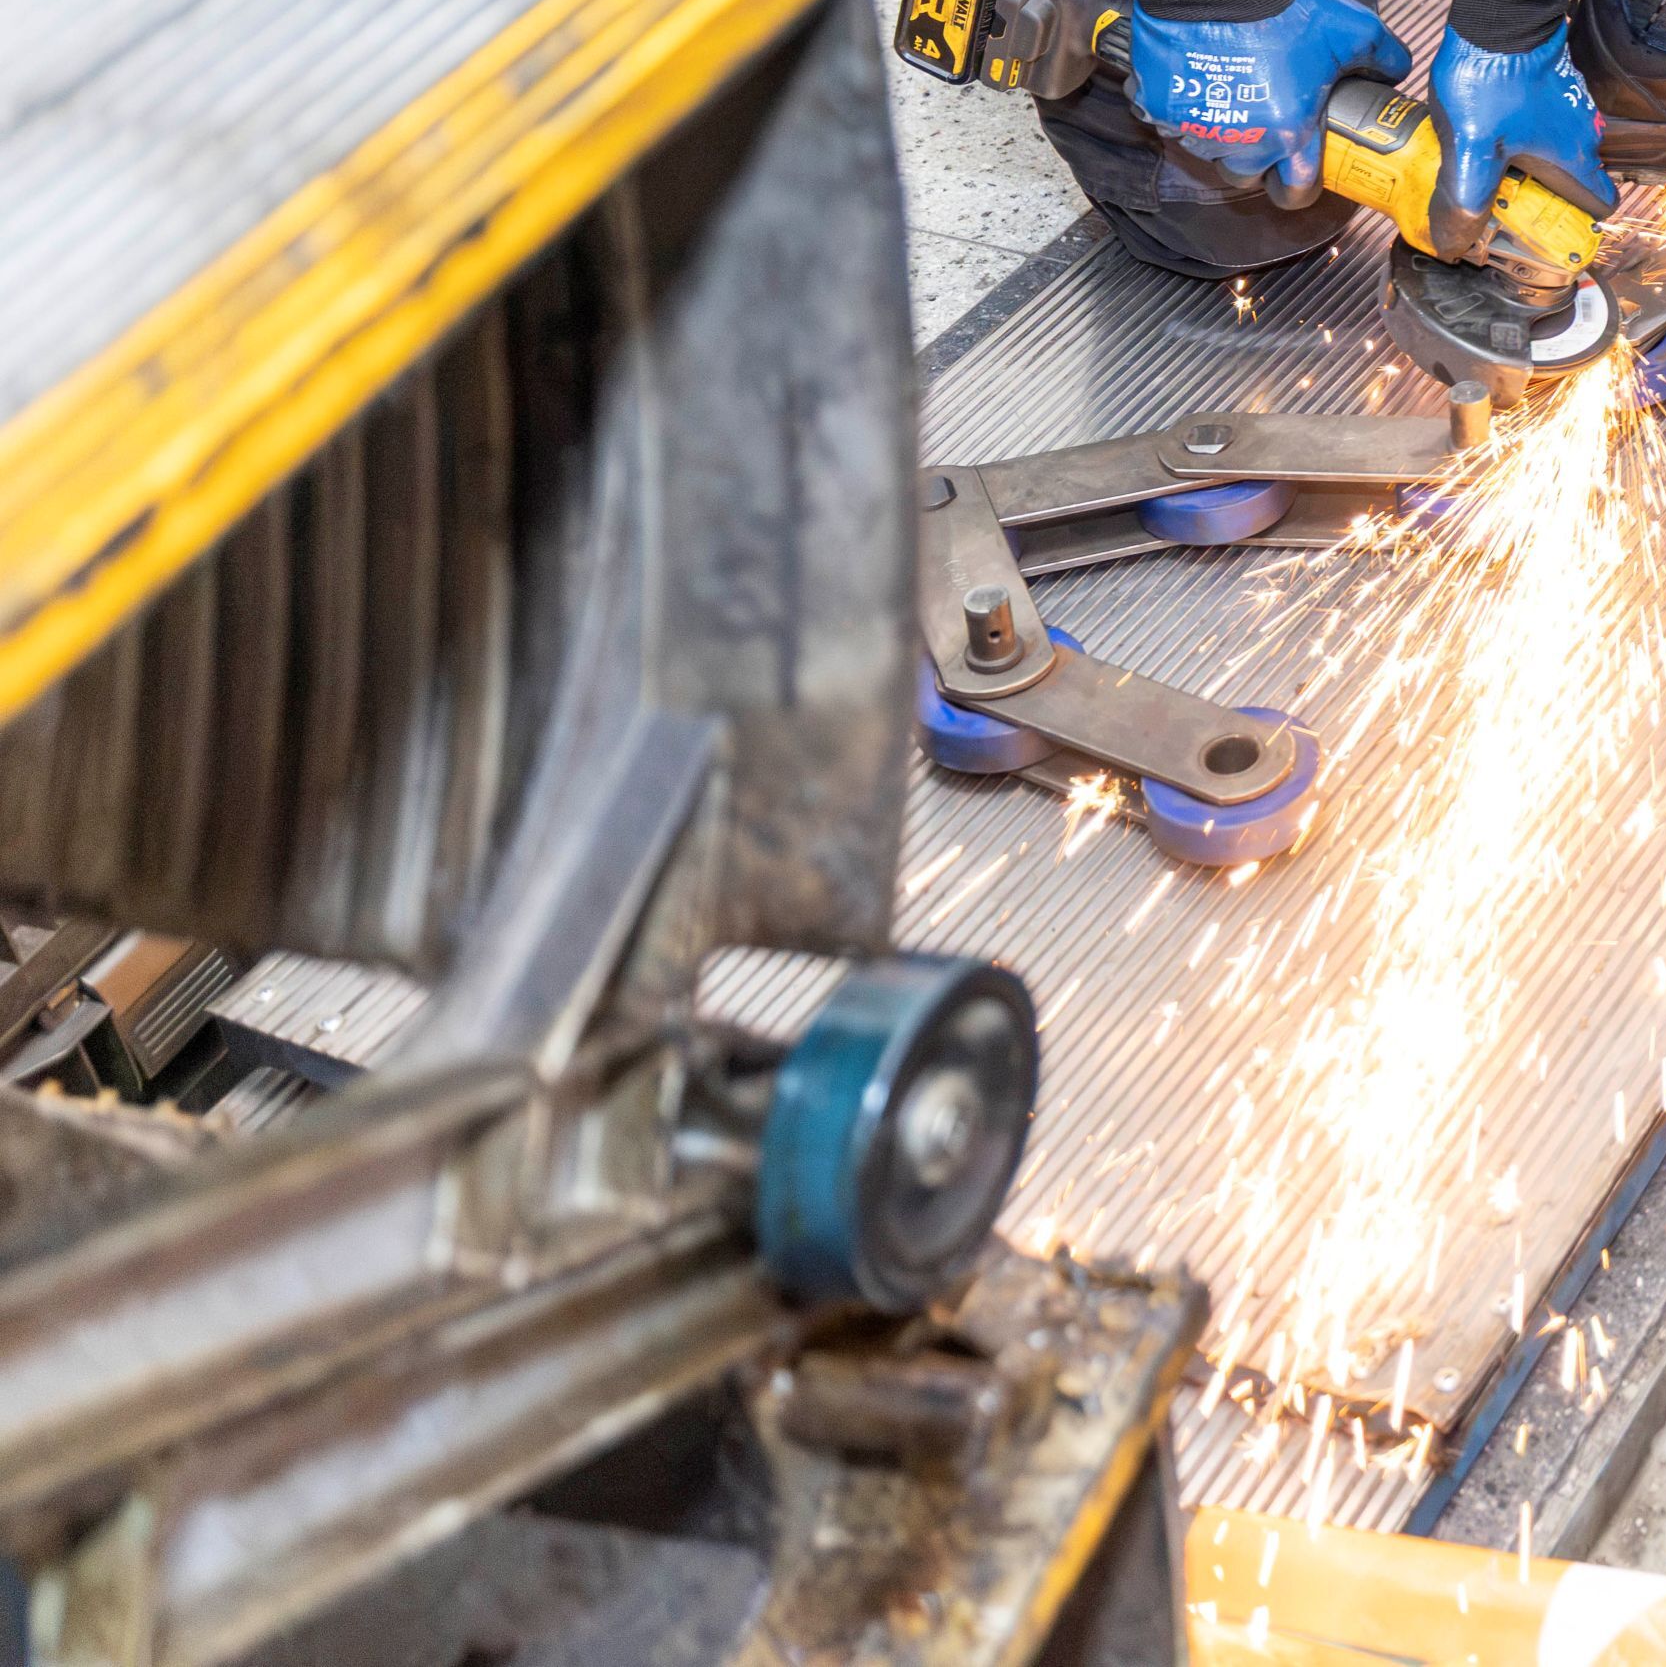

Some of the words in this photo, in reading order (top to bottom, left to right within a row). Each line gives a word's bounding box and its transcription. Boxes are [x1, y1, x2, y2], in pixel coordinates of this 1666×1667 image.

[922, 38, 941, 60] 4
[1185, 51, 1220, 63] Türkiye
[1220, 55, 1230, 63] in
[1231, 56, 1256, 64] Made
[1188, 60, 1223, 73] 10/XL
[1225, 65, 1253, 74] Size:
[1188, 107, 1249, 124] NMF+
